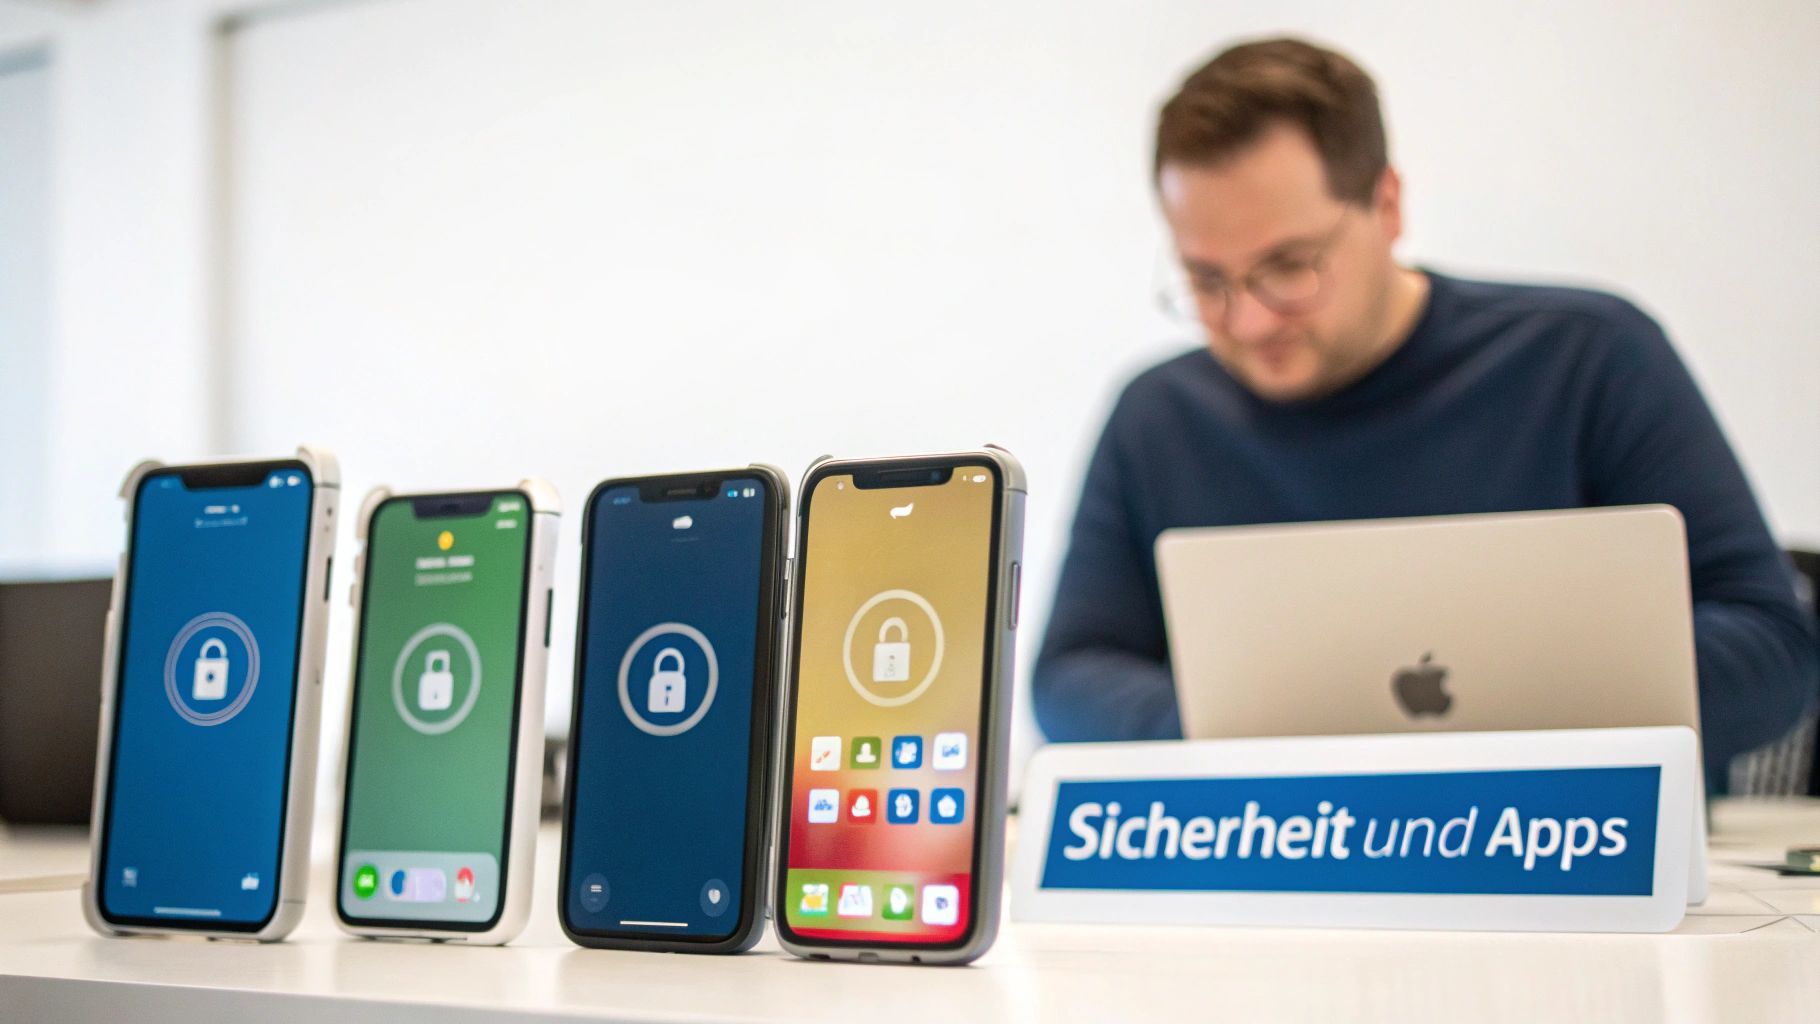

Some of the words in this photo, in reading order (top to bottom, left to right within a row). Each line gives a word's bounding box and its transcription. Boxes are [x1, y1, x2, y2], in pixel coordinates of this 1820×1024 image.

[1062, 800, 1356, 860] Sicherheit
[1363, 807, 1481, 859] und
[1485, 807, 1629, 872] Apps
